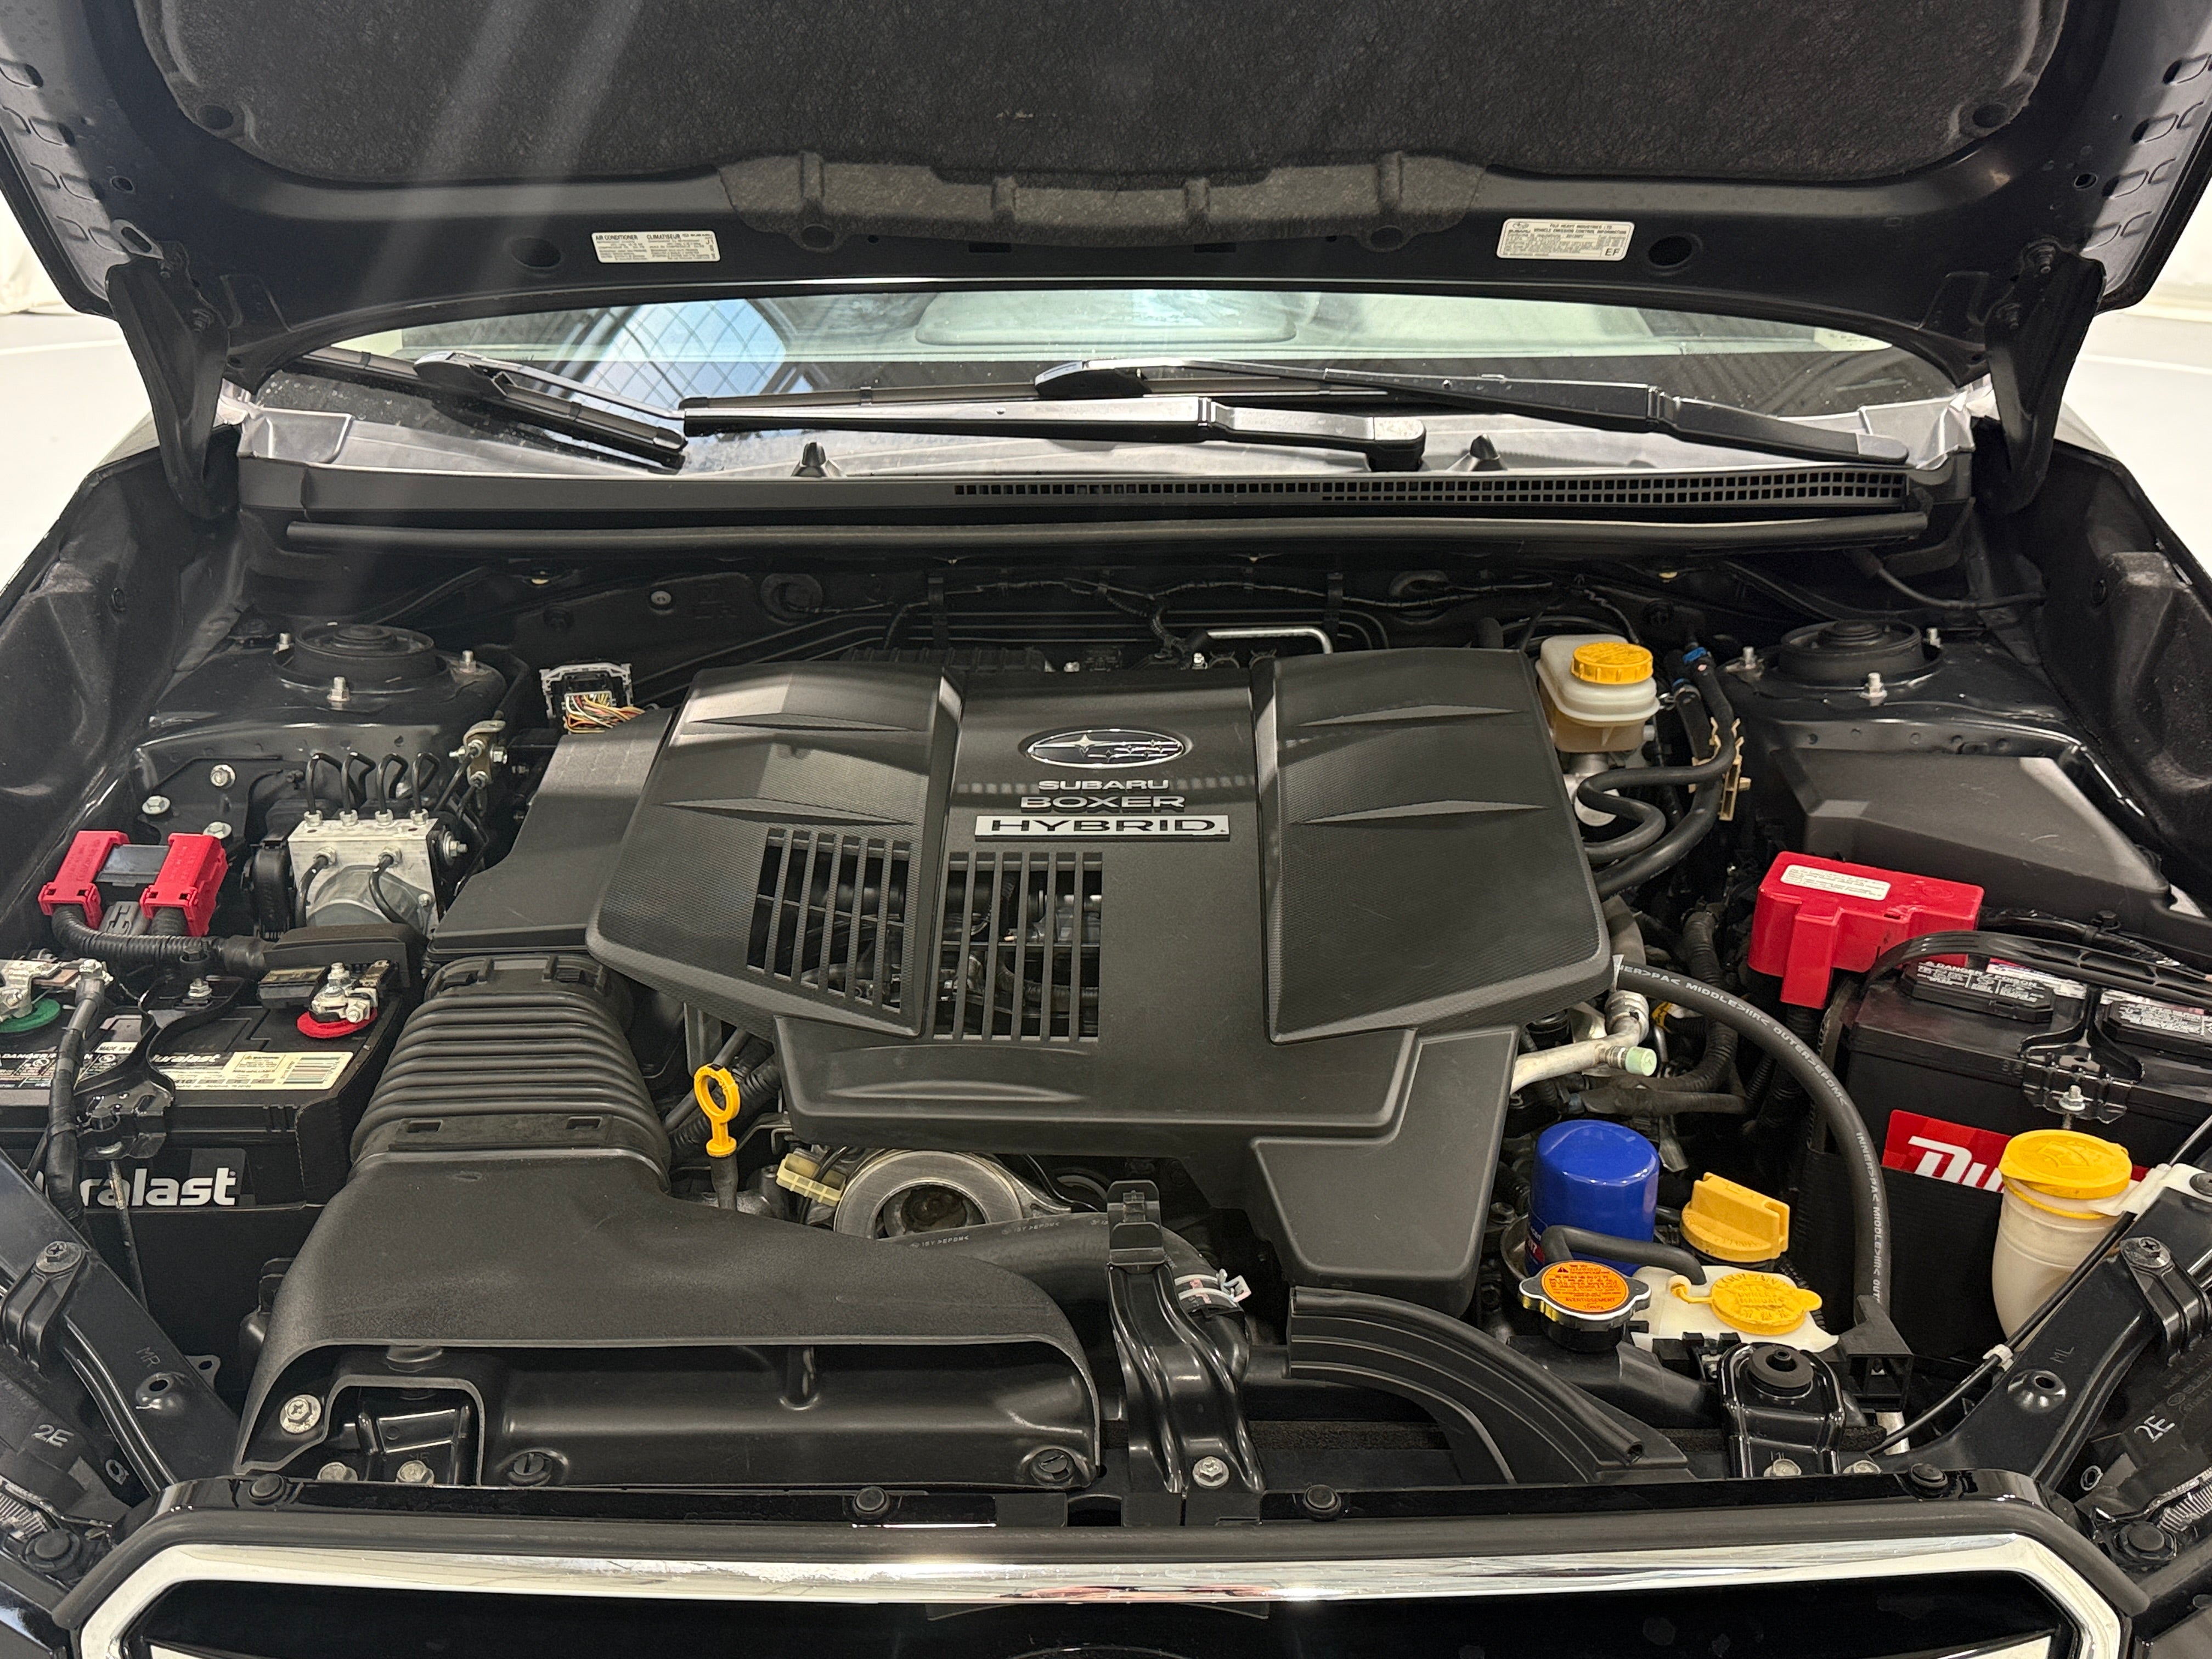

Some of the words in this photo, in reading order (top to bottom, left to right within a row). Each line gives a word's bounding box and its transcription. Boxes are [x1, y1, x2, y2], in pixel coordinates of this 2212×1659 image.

[1605, 248, 1621, 256] EF
[1039, 780, 1169, 791] SUBARU
[1020, 796, 1185, 808] BOXER
[991, 820, 1215, 832] HYBRID
[136, 1347, 160, 1368] MR
[31, 1424, 75, 1448] 2E
